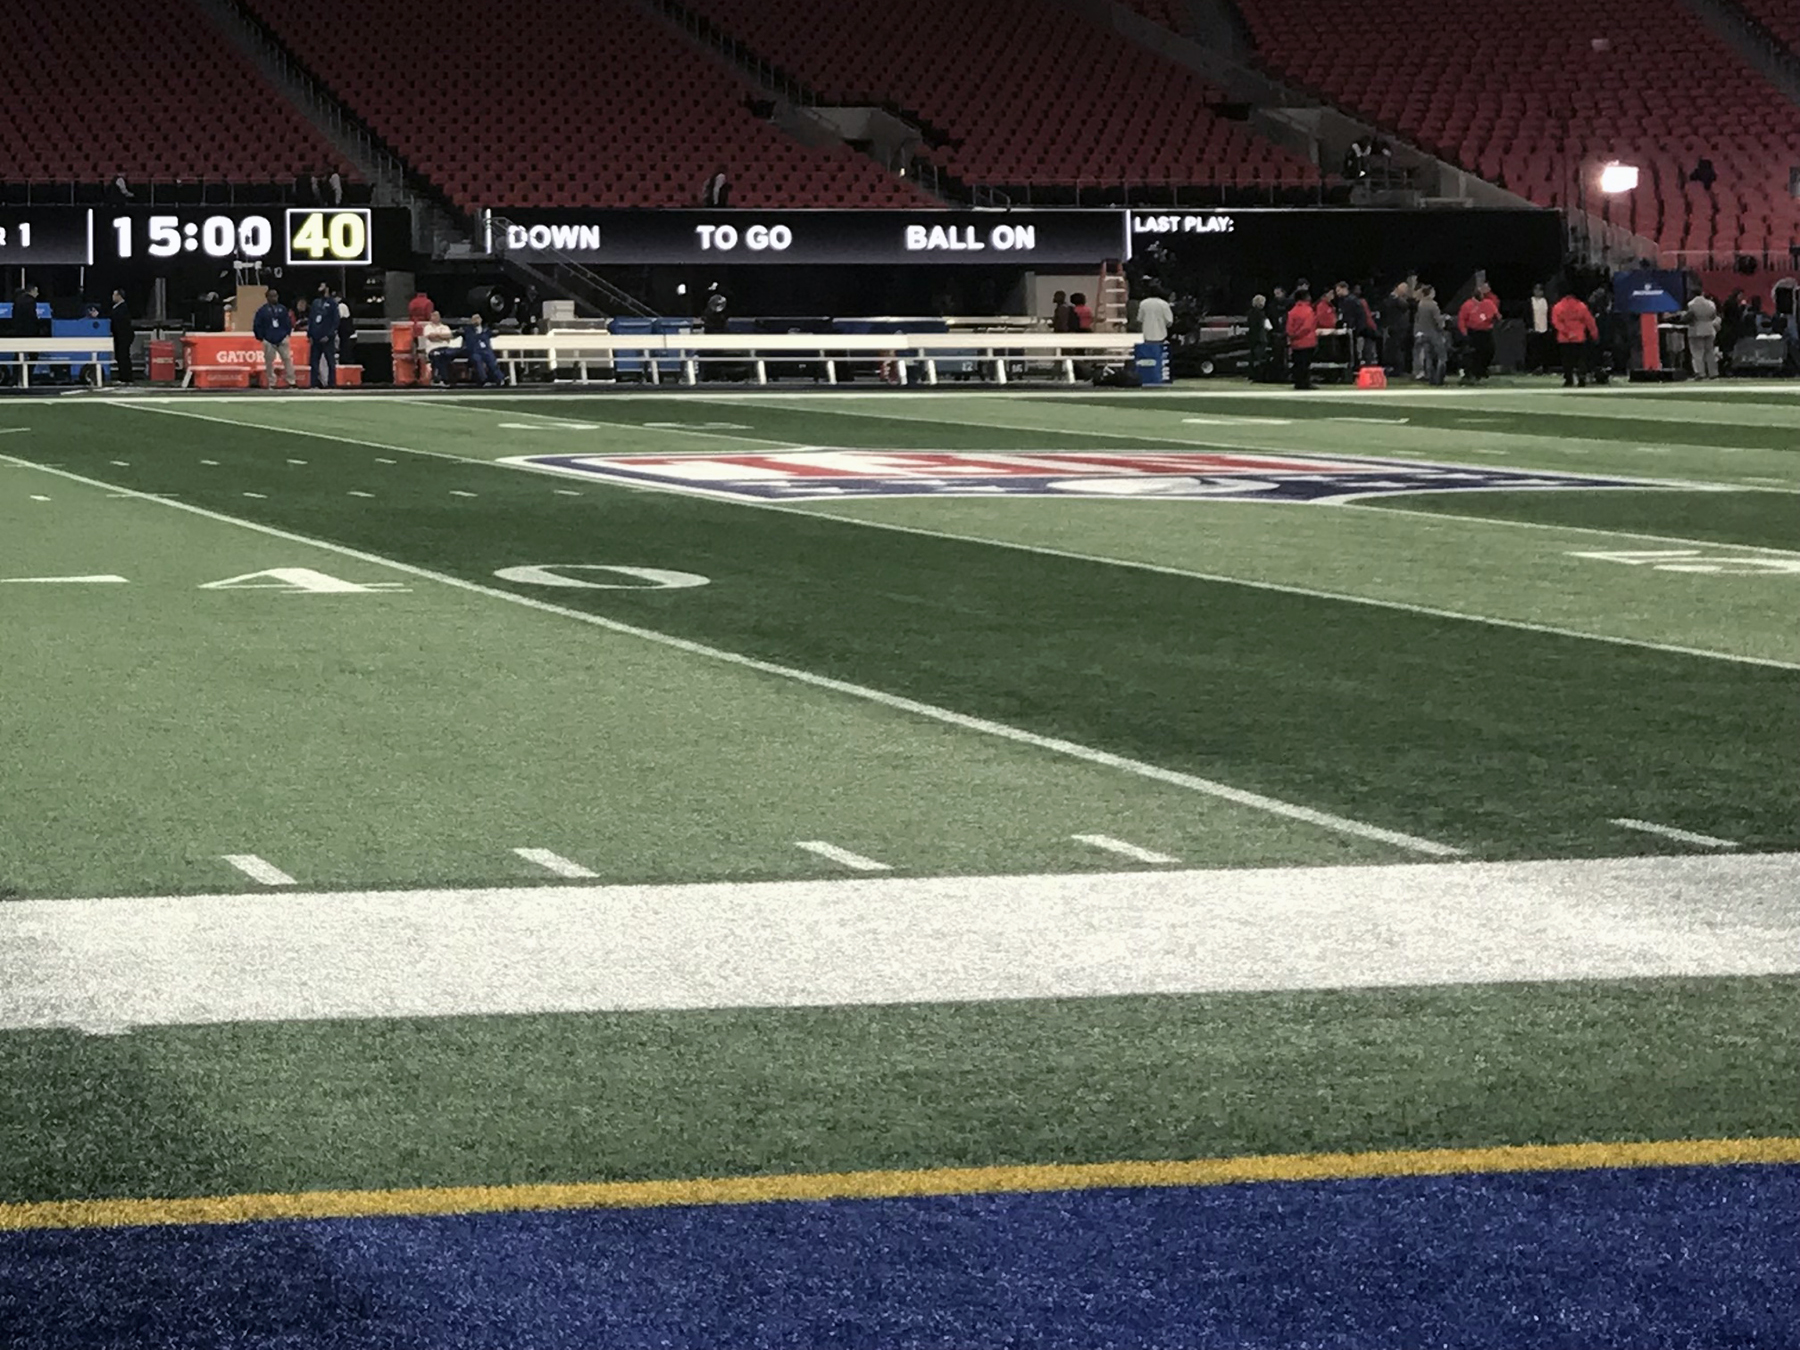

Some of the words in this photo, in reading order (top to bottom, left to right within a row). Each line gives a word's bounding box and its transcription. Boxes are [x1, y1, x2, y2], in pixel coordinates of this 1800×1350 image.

[19, 223, 31, 248] 1
[114, 216, 273, 258] 15:00
[294, 213, 365, 258] 40
[507, 225, 601, 250] DOWN
[697, 225, 739, 251] TO
[746, 225, 794, 251] GO
[906, 226, 985, 251] BALL
[992, 225, 1037, 251] ON
[1134, 216, 1181, 234] LAST
[1184, 216, 1236, 234] PLAY:
